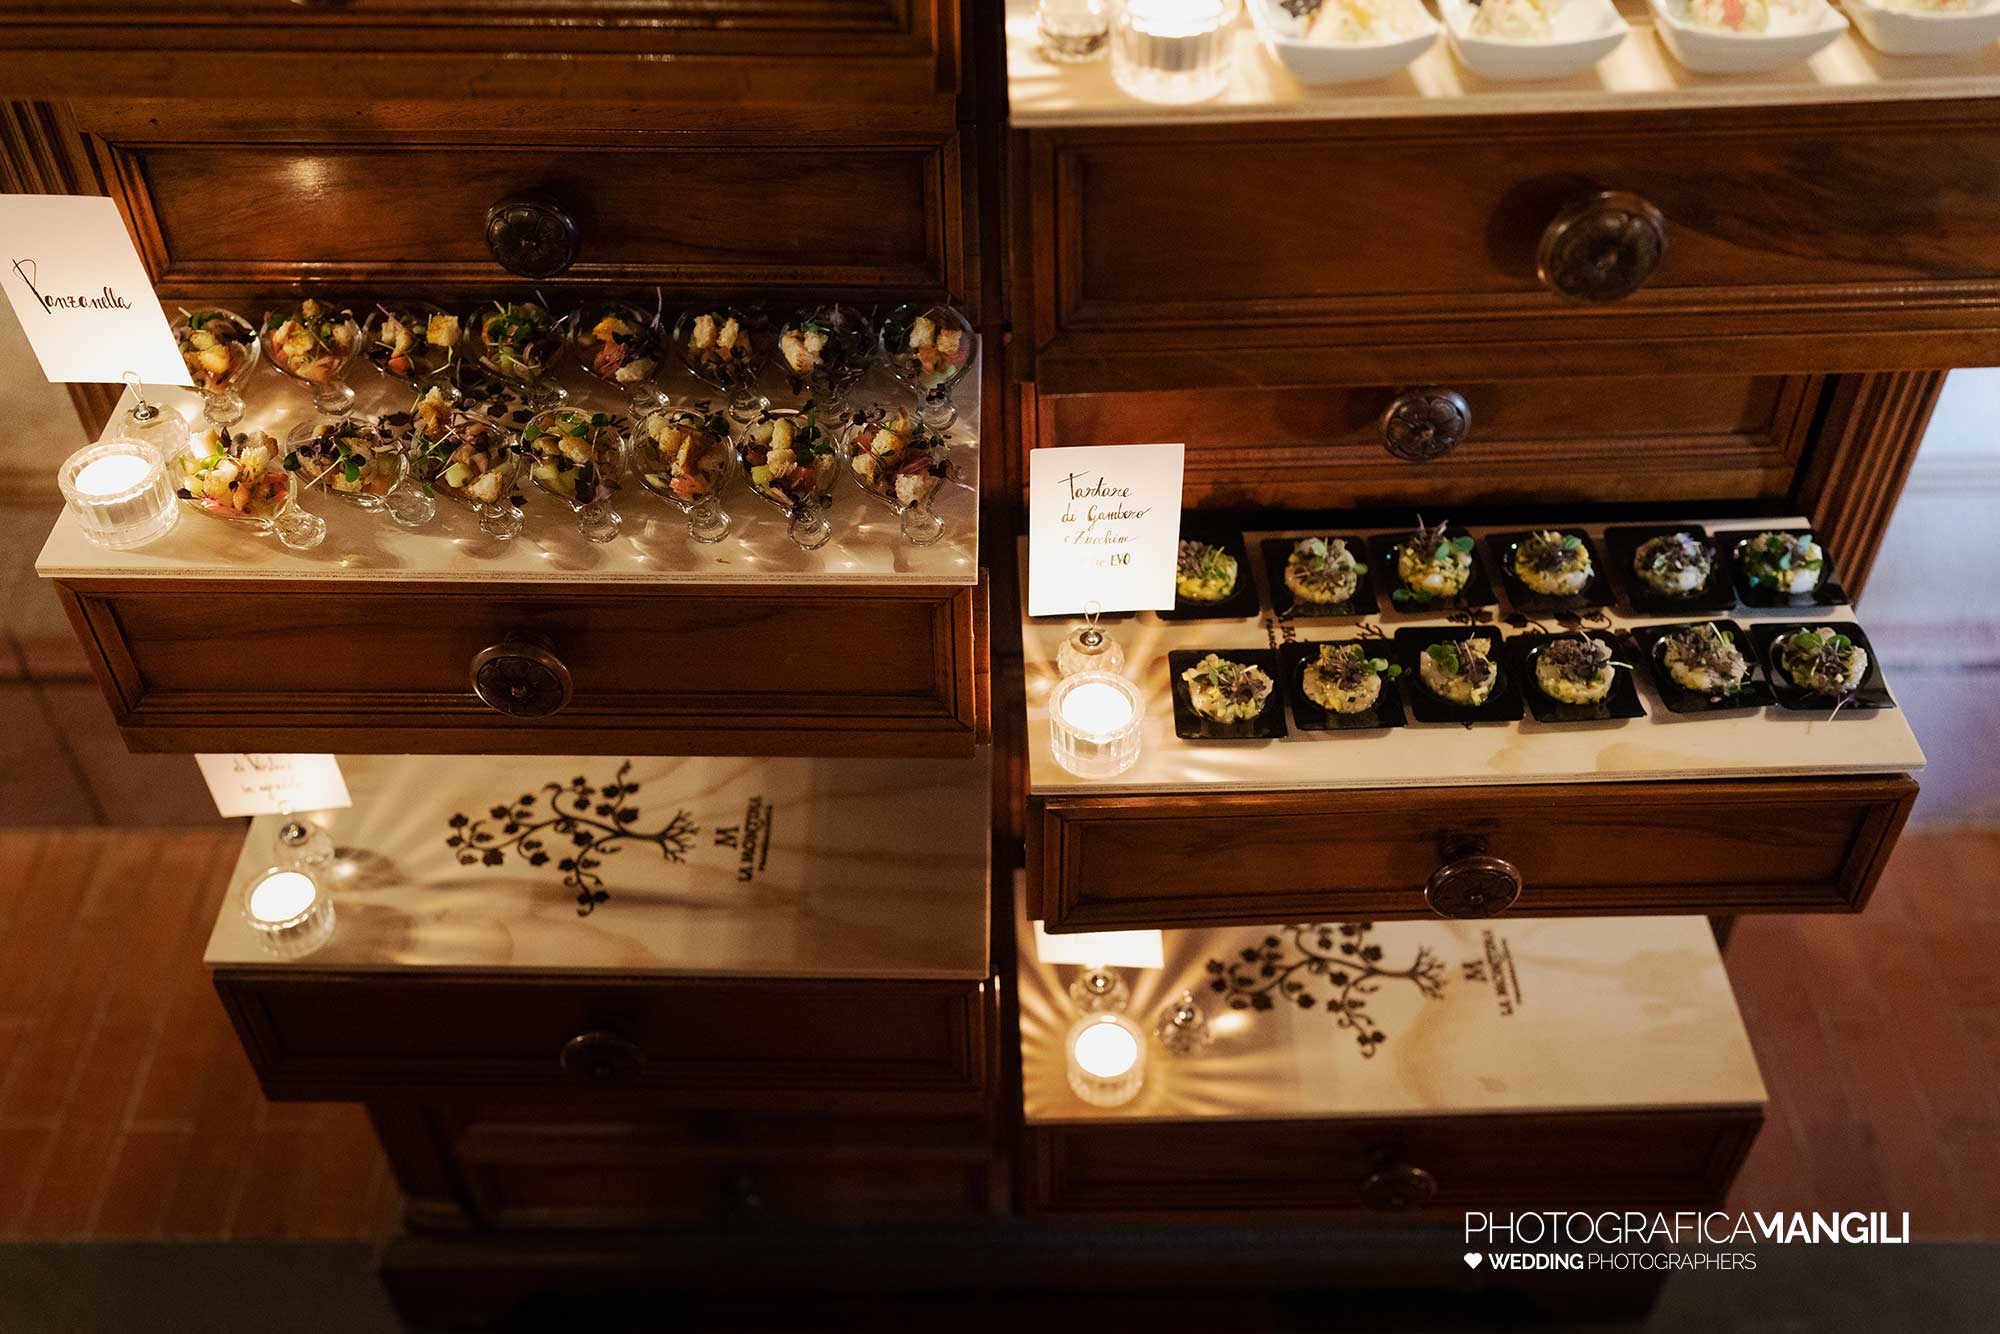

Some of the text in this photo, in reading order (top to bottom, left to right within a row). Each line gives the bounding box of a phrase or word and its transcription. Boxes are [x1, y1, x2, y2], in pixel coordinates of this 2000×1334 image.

[12, 258, 132, 314] Panzanella
[1057, 470, 1134, 500] Tartare
[1061, 503, 1152, 531] di Gambero
[714, 826, 739, 849] M
[737, 866, 753, 882] LA
[1462, 960, 1487, 982] M
